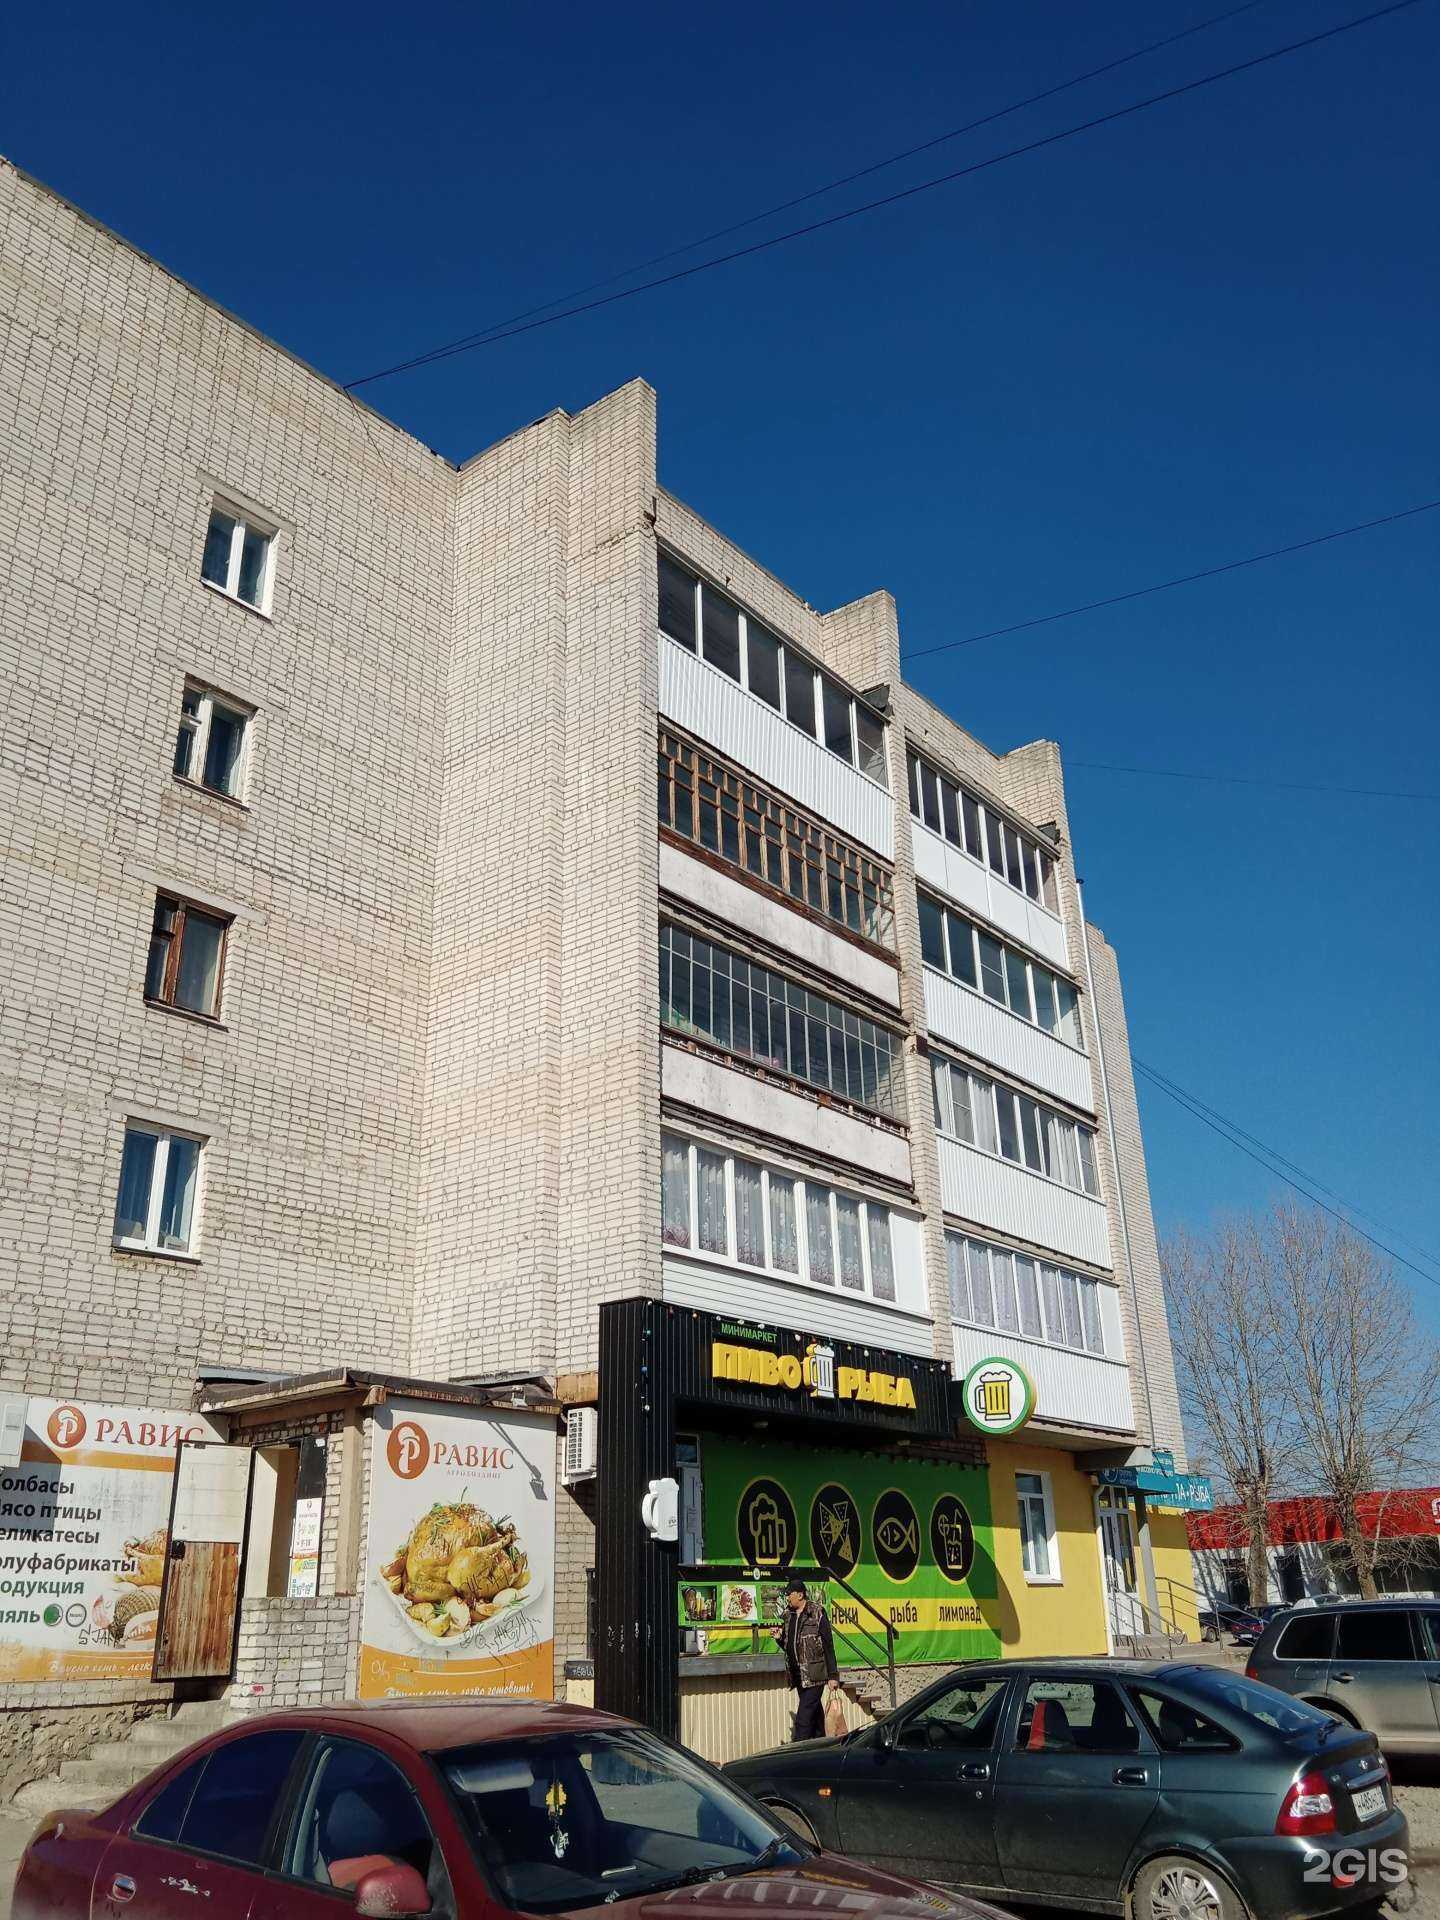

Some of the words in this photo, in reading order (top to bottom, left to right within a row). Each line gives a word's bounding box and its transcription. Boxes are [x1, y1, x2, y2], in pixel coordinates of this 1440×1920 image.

[721, 1323, 778, 1344] МИНИМАРКЕТ
[712, 1342, 801, 1389] ПИВО
[837, 1366, 917, 1409] РЫБА
[433, 1442, 515, 1470] РАВИС
[0, 1475, 74, 1495] олбасы
[0, 1501, 35, 1517] ясо
[40, 1504, 102, 1525] птицы
[0, 1527, 99, 1544] еликатесы
[0, 1552, 136, 1575] луфабрикаты
[0, 1579, 84, 1598] одукция
[0, 1607, 40, 1624] яль
[831, 1604, 859, 1625] неки
[890, 1604, 918, 1625] рыба
[939, 1603, 981, 1624] лимонад
